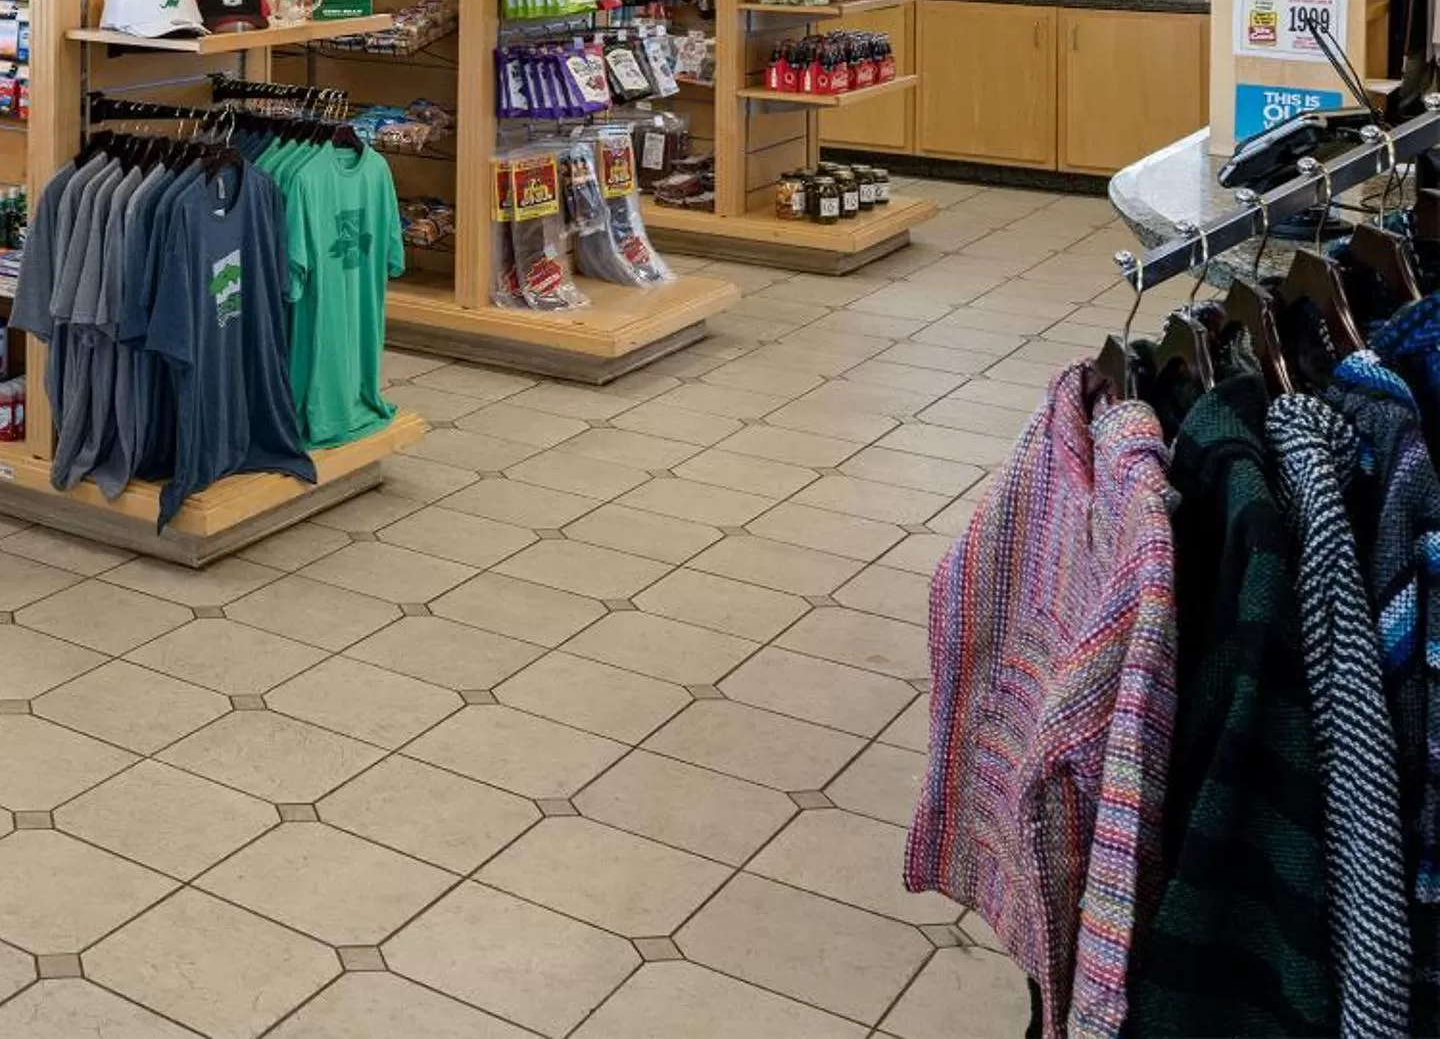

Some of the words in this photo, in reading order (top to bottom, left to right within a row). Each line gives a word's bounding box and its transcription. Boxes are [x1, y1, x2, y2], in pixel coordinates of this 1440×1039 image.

[1264, 92, 1301, 106] THIS
[1305, 94, 1321, 107] IS
[1263, 104, 1315, 121] OU
